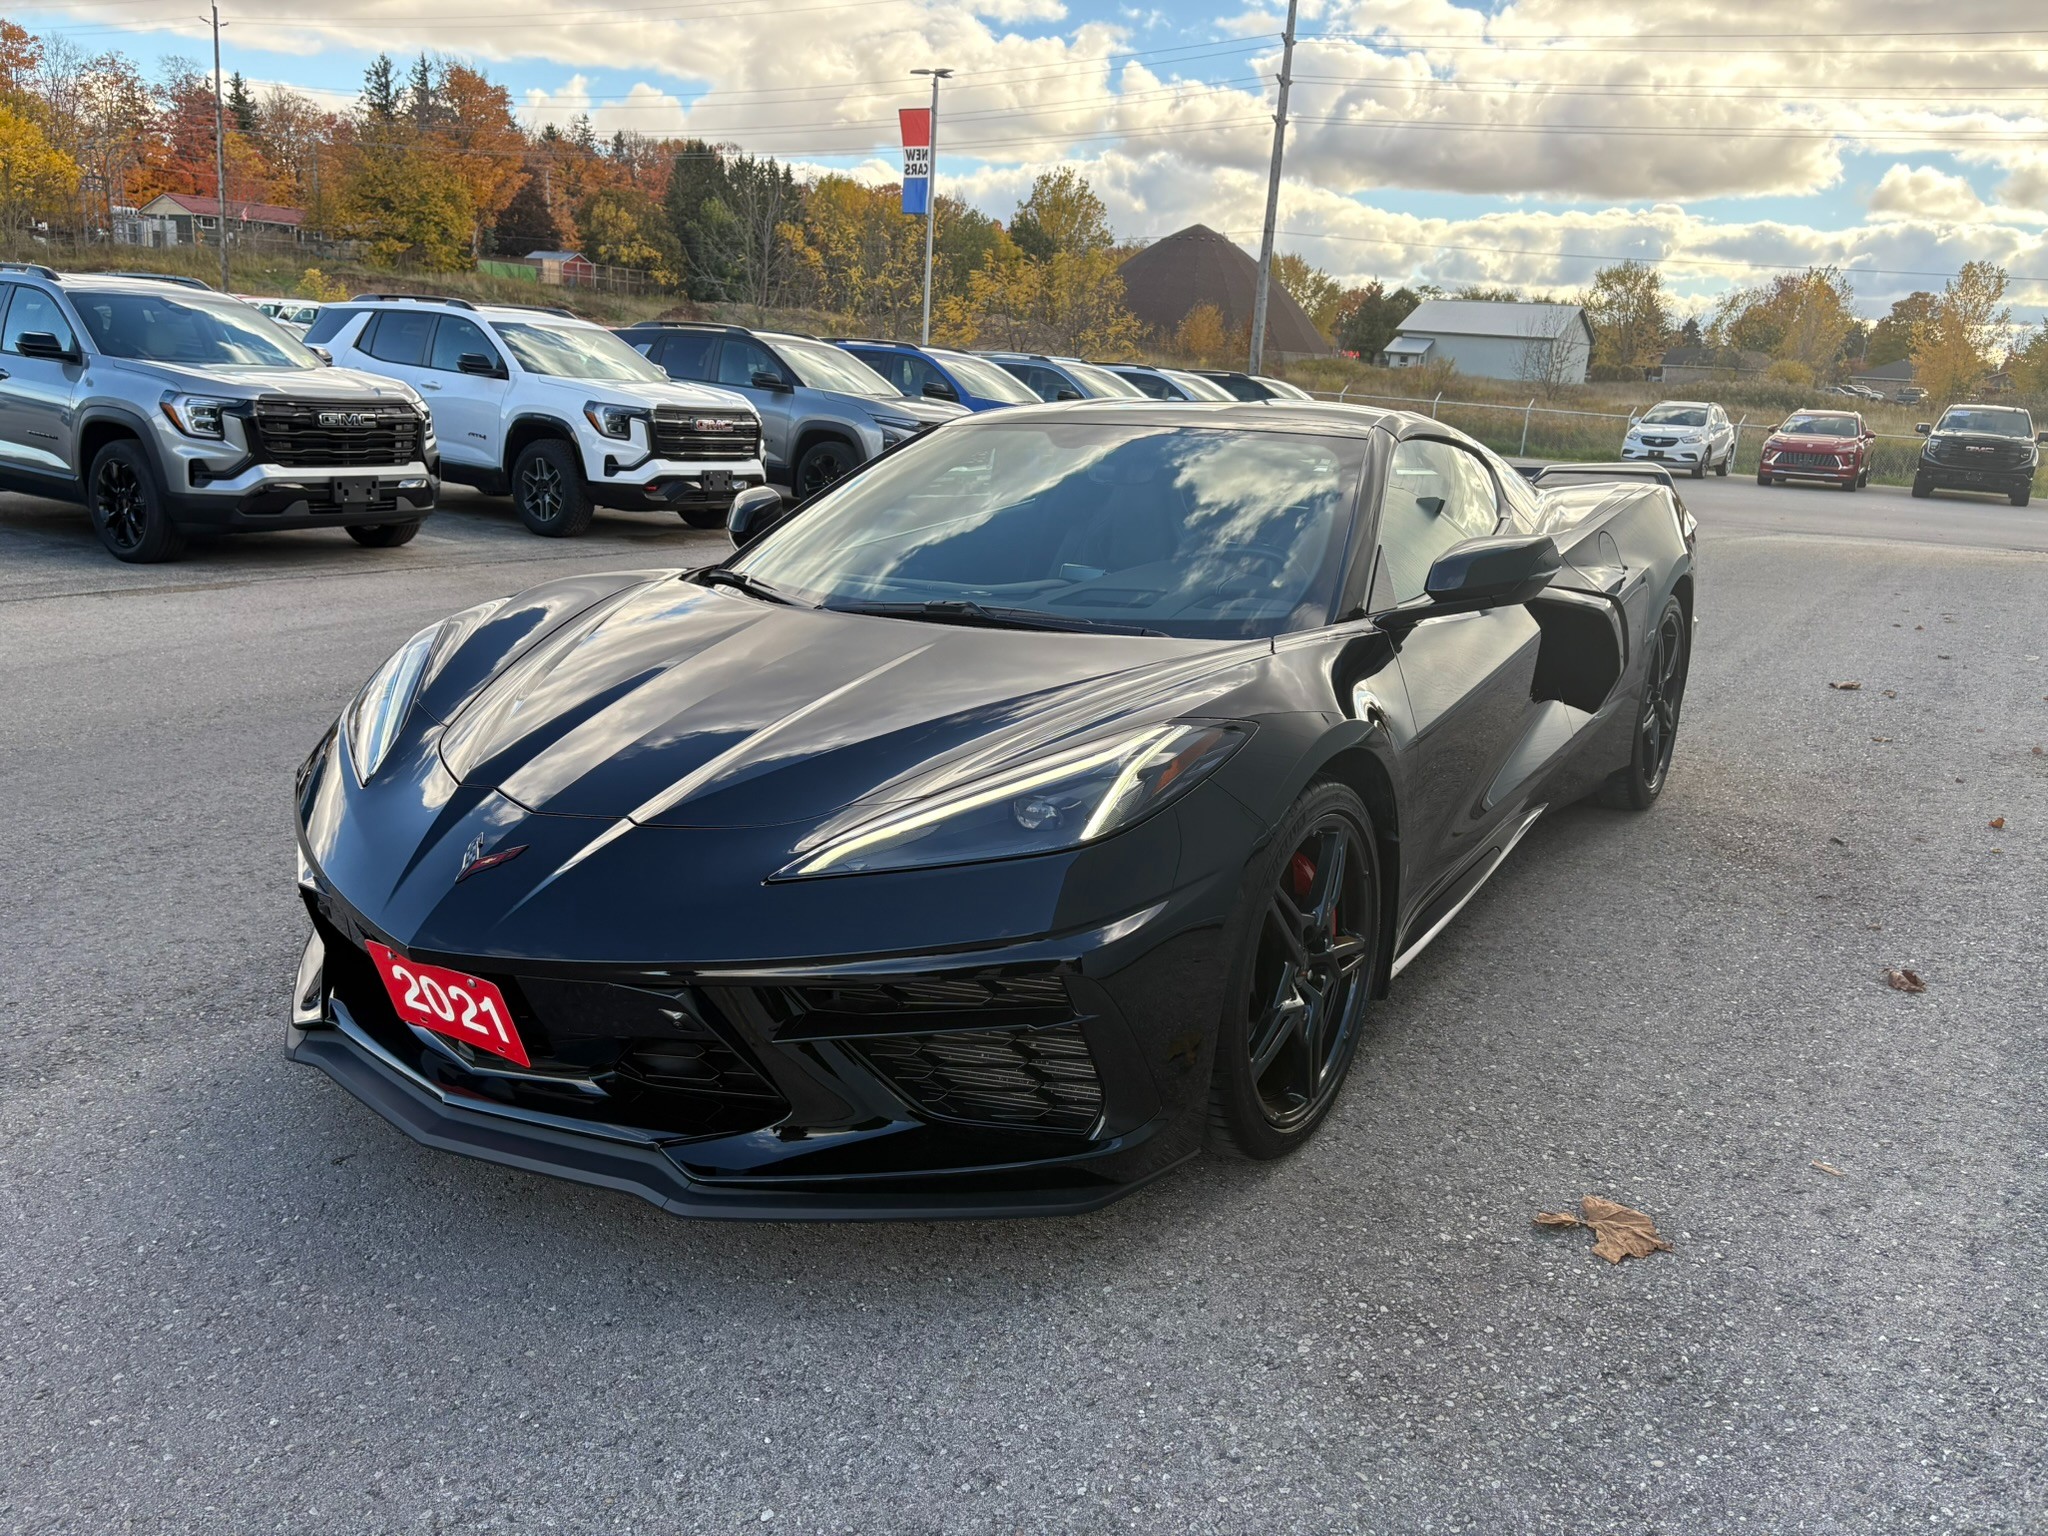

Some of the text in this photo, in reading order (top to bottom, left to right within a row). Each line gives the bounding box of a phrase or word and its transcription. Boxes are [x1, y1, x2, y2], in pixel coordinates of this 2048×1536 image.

[318, 412, 377, 428] GMC
[696, 419, 734, 432] GMC
[391, 964, 511, 1044] 2021
